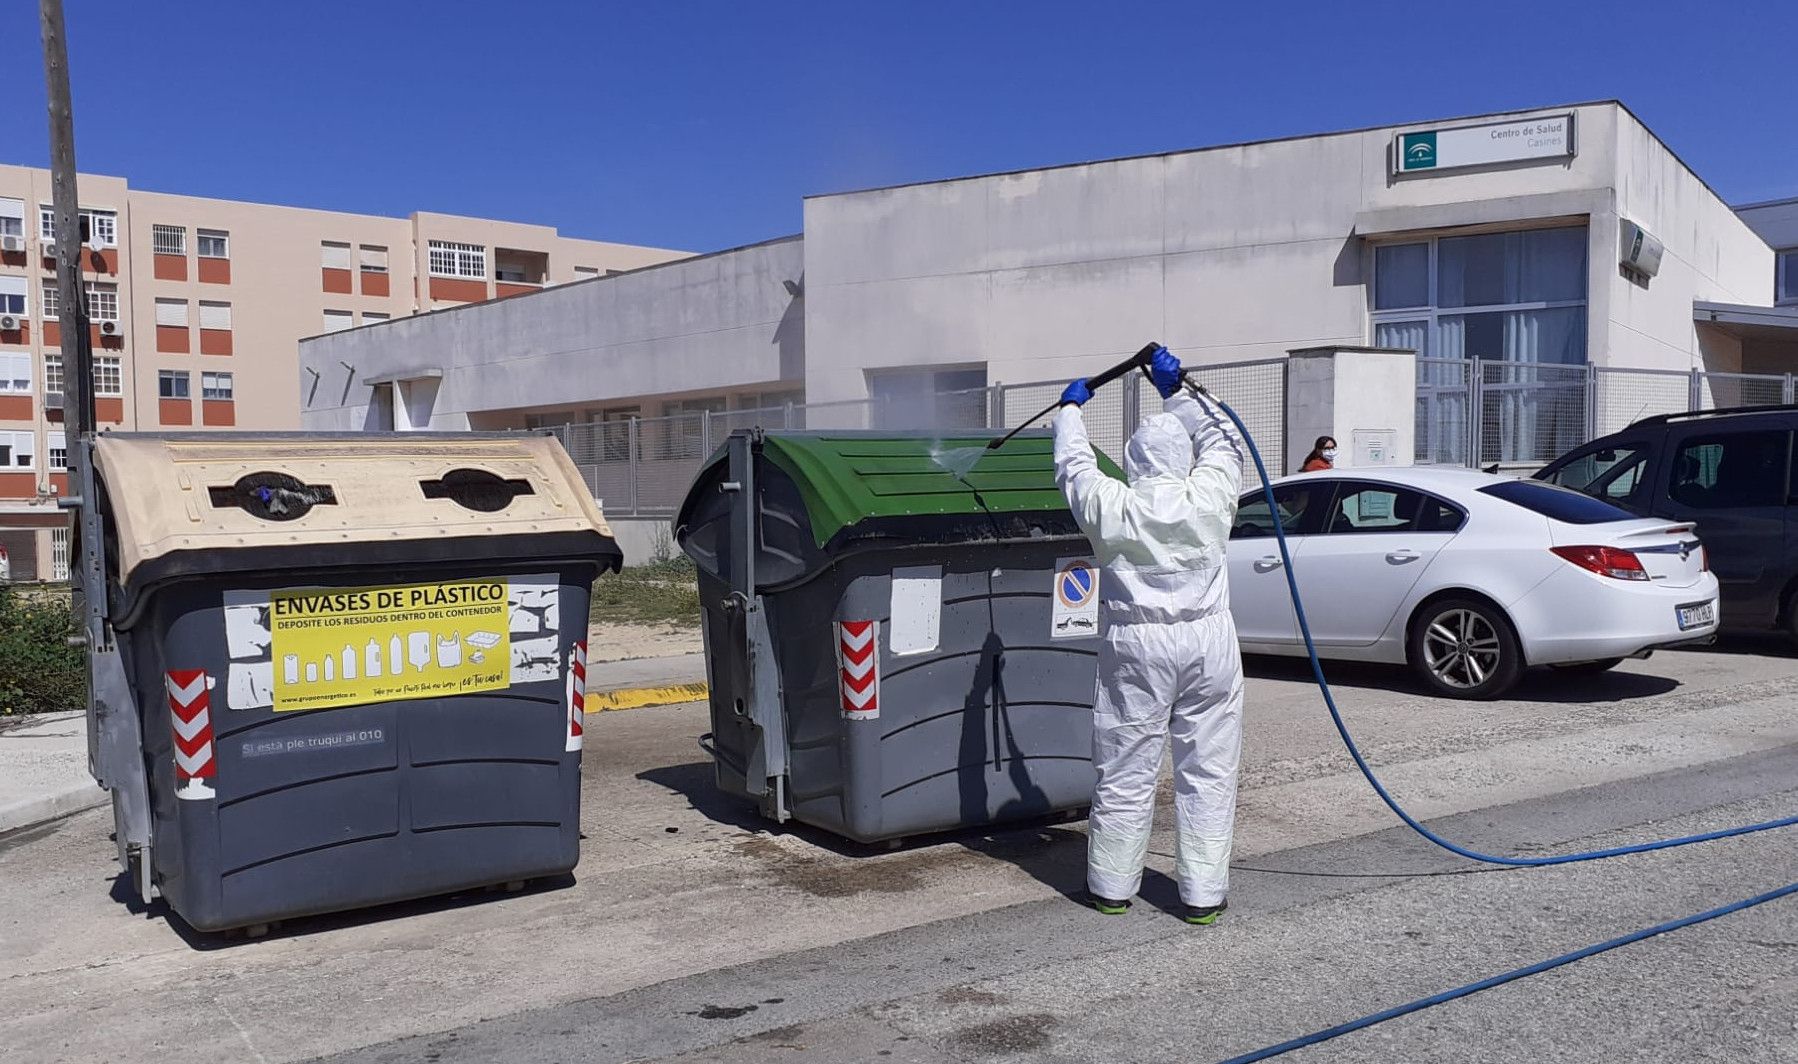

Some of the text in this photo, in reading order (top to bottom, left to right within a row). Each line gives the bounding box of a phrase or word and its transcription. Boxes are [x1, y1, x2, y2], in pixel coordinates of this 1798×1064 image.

[1490, 123, 1562, 139] Centro de Salud
[1527, 137, 1562, 148] Casines
[275, 583, 504, 615] ENVASES DE PLÁSTICO
[277, 606, 502, 630] DEPOSITE LOS RESIDUOS DENTRO DEL CONTENEDOR
[242, 743, 254, 754] Si
[308, 734, 342, 747] truqui
[345, 732, 356, 743] al
[359, 729, 382, 741] 010
